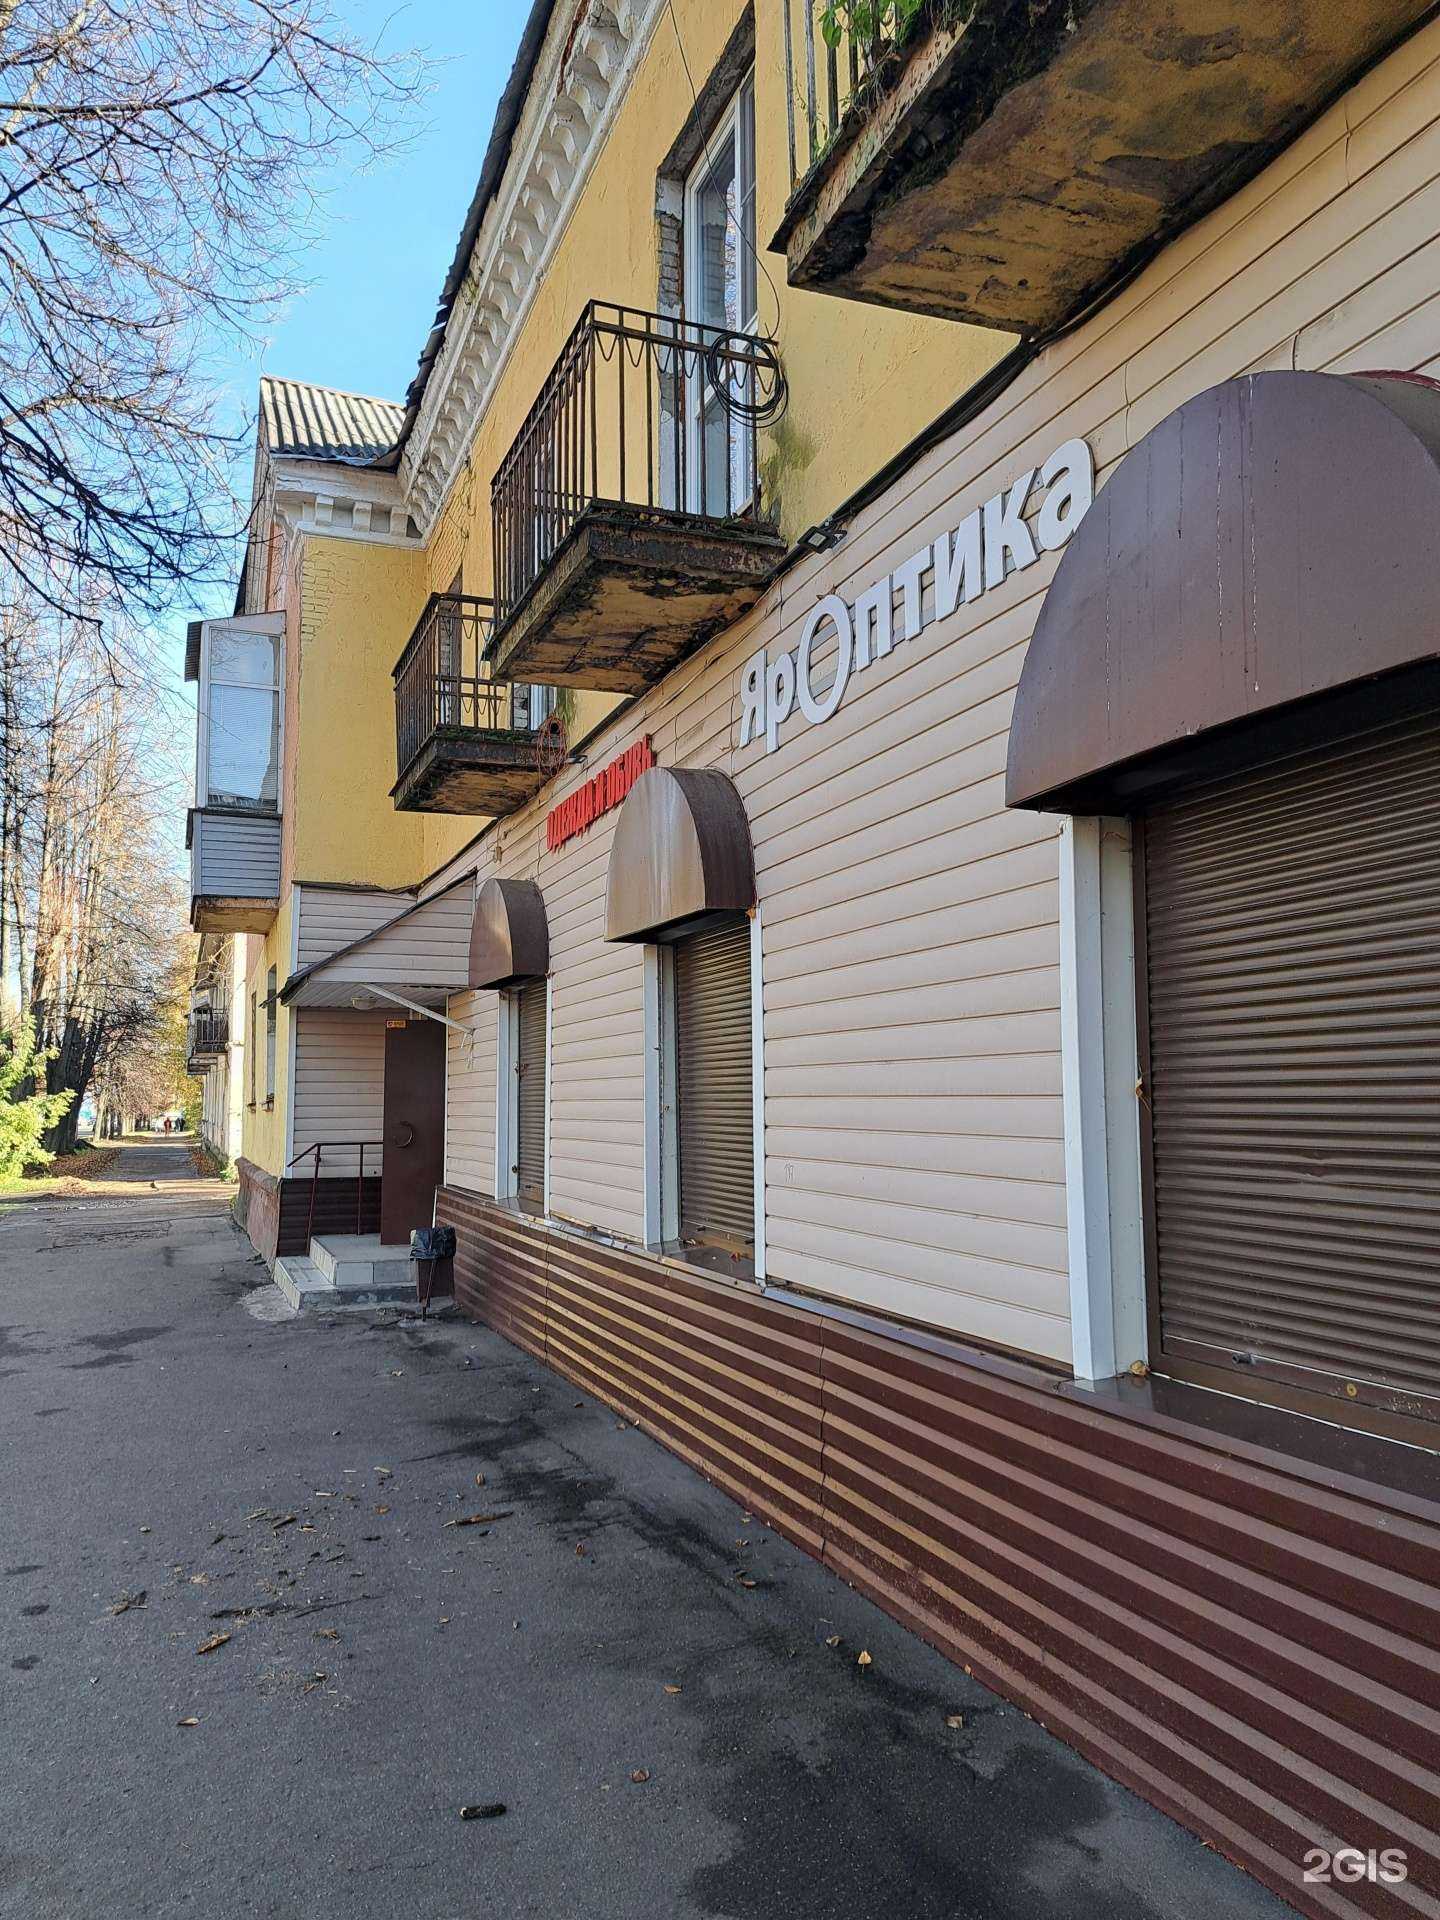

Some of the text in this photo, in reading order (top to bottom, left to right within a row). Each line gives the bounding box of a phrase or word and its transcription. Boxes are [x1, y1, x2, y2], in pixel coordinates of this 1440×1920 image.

[740, 438, 1095, 753] ЯрОптика
[547, 779, 595, 854] ОДЕЖДА
[594, 769, 606, 814] И
